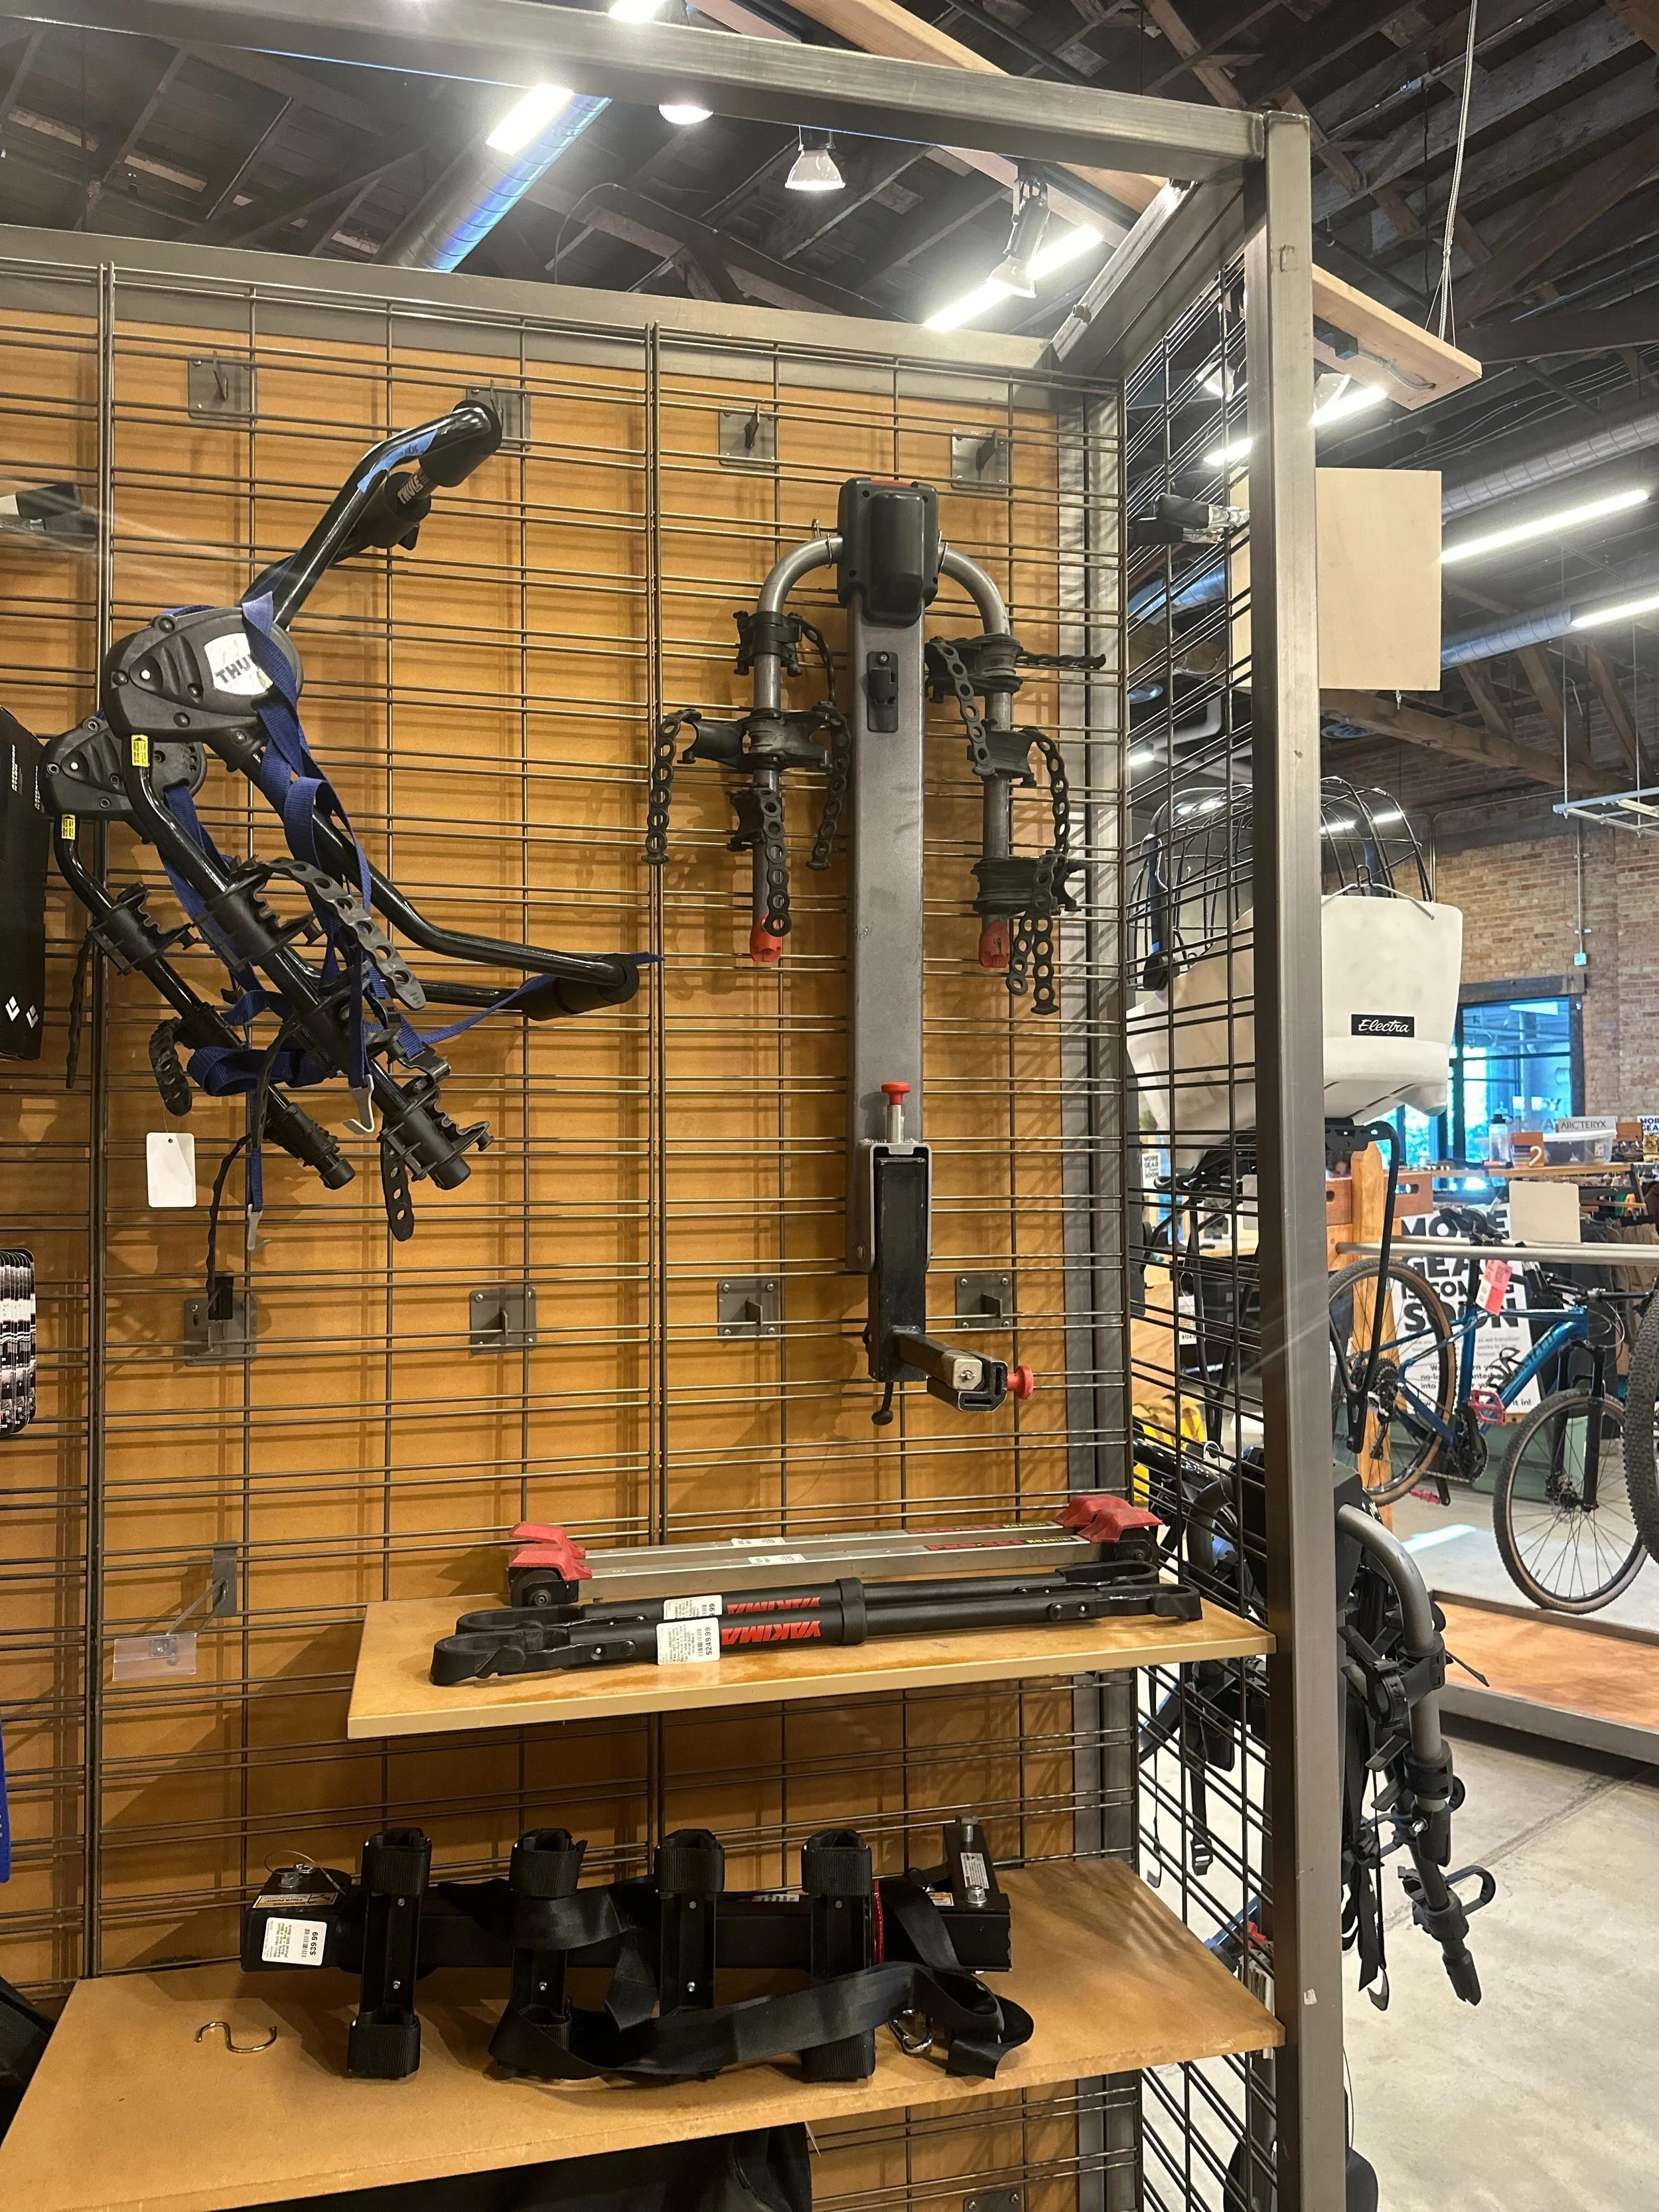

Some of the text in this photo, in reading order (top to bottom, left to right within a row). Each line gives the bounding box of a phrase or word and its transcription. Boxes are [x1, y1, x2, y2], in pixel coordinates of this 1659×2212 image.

[397, 474, 423, 504] THULE
[214, 655, 252, 684] THU
[1358, 1019, 1410, 1033] Electra
[1401, 1209, 1510, 1238] MOE
[1404, 1299, 1520, 1331] SN
[721, 1621, 821, 1645] YAKIMA
[310, 1931, 319, 1956] $39.99
